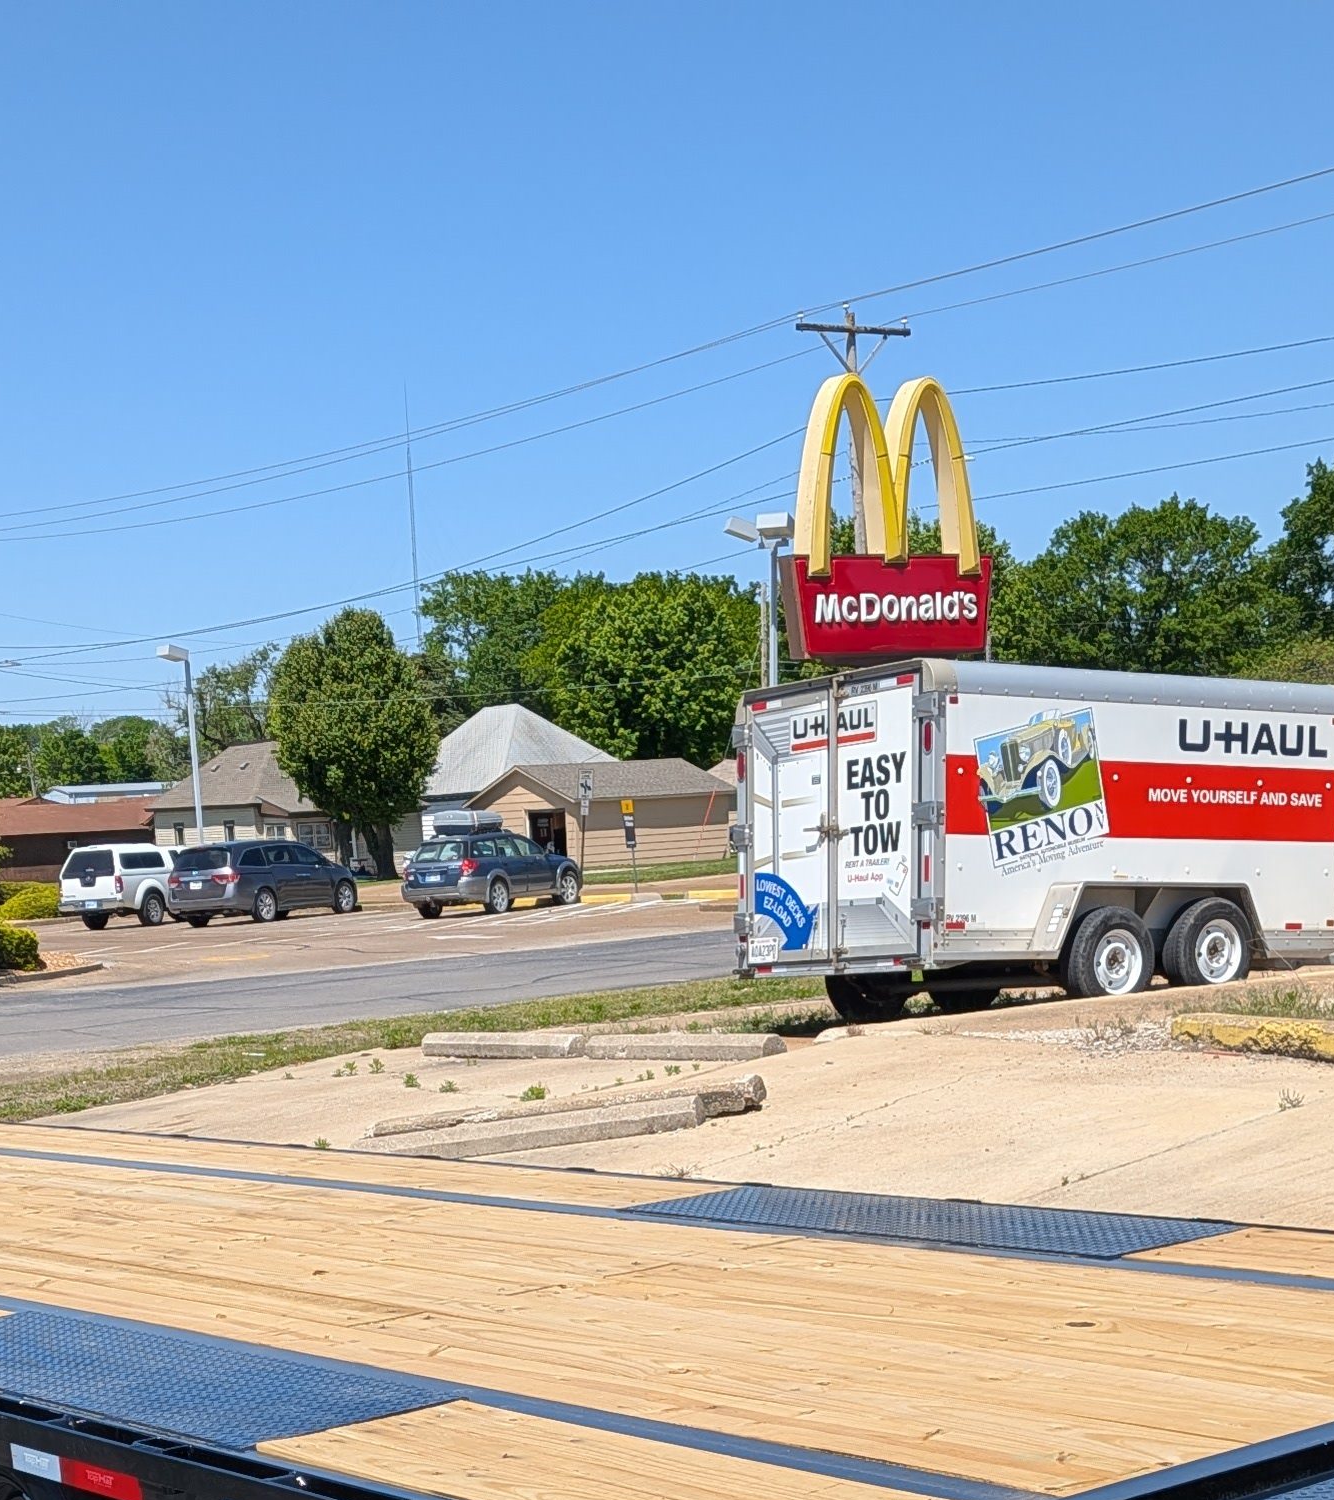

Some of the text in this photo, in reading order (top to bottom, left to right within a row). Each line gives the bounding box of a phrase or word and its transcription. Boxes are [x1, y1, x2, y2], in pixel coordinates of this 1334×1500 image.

[814, 590, 978, 624] McDonald's
[793, 708, 874, 740] U-HAUL
[1179, 718, 1328, 758] U-HAUL
[846, 751, 907, 790] EASY
[860, 788, 890, 822] TO
[1148, 787, 1323, 808] MOVE YOURSELF AND SAVE
[850, 820, 901, 857] TOW
[991, 806, 1093, 862] RENO
[1001, 839, 1105, 877] America's Moving Adventure
[847, 872, 884, 883] U-Haul App
[756, 879, 805, 928] LOWEST DECKS
[763, 897, 792, 929] EZ-LOAD
